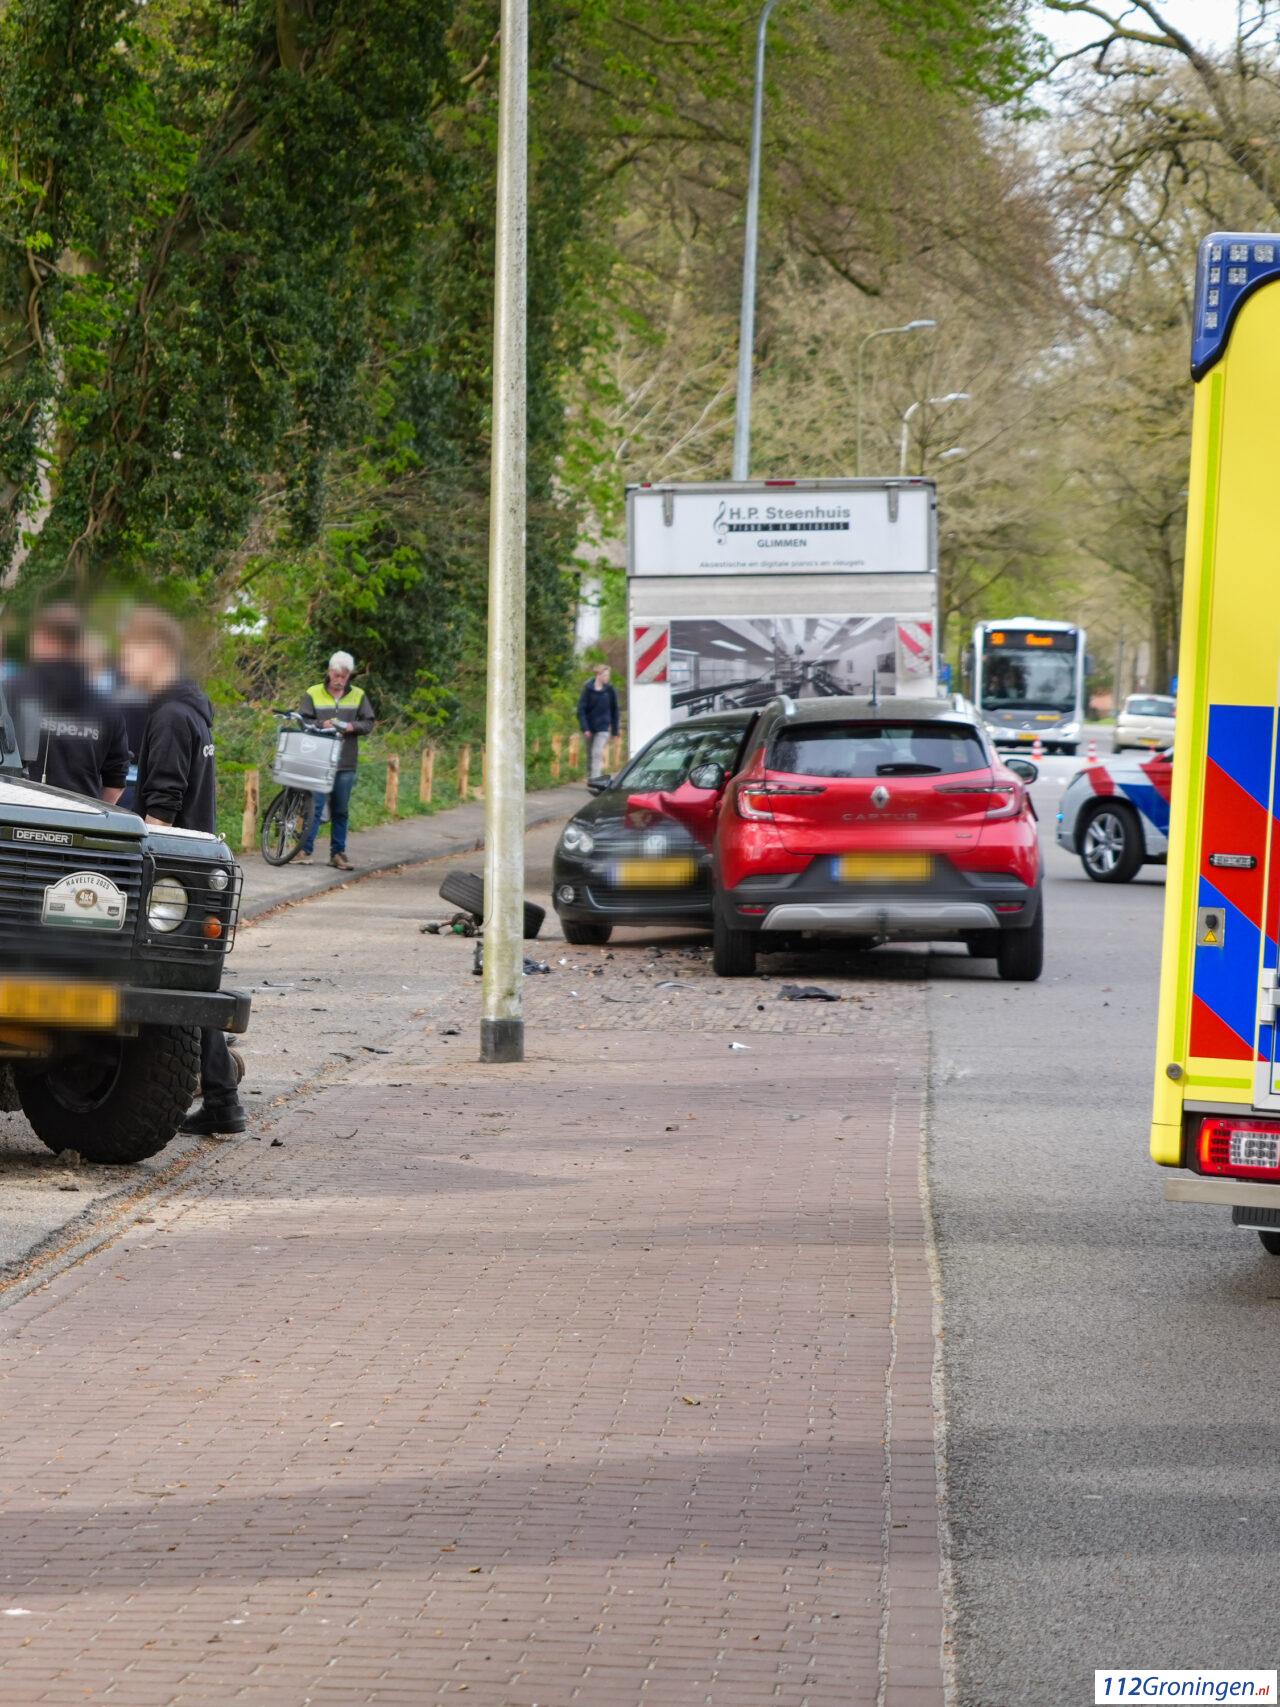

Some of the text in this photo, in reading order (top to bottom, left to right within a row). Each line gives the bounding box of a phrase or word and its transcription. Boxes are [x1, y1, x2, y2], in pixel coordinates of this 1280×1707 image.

[728, 505, 851, 520] H.P. Steenhuis
[757, 538, 808, 548] GLIMMEN
[40, 718, 100, 741] aspe.rs
[842, 813, 918, 822] CAPTUR
[16, 830, 69, 844] DEFENDER
[65, 876, 95, 887] HAVELTE
